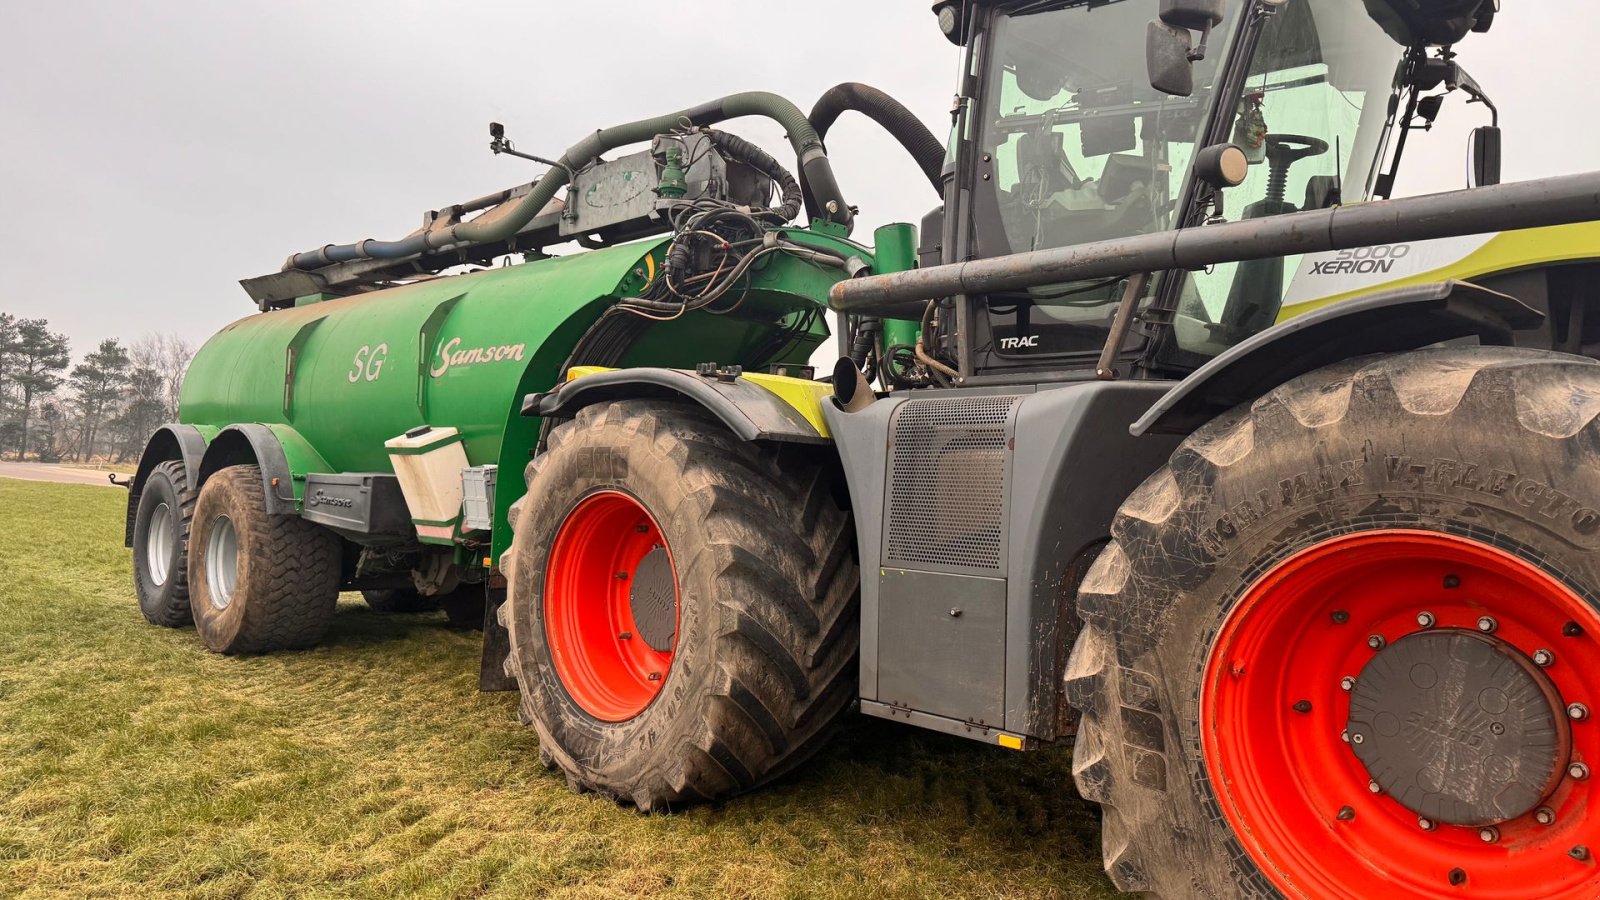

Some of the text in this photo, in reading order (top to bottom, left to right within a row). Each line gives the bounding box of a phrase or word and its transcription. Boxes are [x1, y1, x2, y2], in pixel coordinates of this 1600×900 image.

[1335, 244, 1411, 261] 5000
[1308, 258, 1395, 275] XERION
[1000, 335, 1040, 349] TRAC
[348, 343, 388, 383] SG
[429, 336, 526, 378] Samson
[310, 488, 353, 508] Samson
